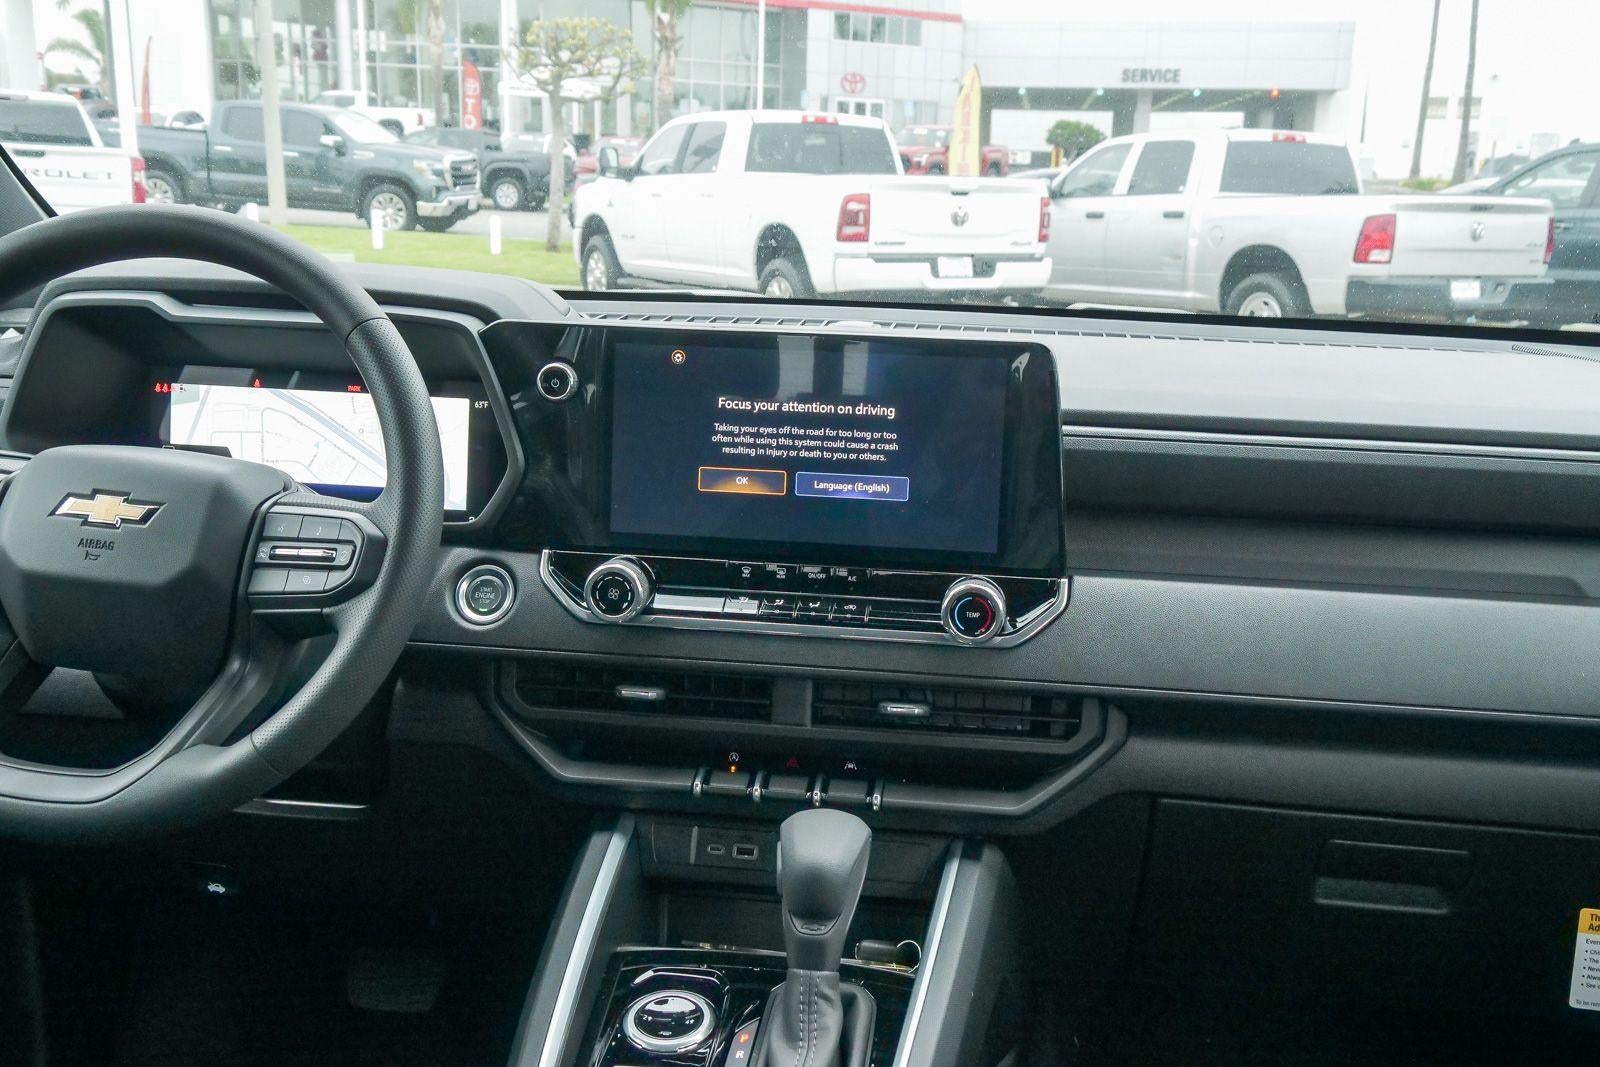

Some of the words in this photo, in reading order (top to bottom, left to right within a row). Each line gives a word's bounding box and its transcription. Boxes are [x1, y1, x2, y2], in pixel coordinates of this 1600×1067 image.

[1121, 67, 1183, 84] SERVICE
[347, 385, 362, 393] PARK
[718, 397, 752, 410] Focus
[753, 401, 779, 413] your
[781, 402, 835, 414] attention
[837, 405, 852, 415] on
[855, 403, 896, 419] driving
[714, 423, 739, 434] Taking
[740, 426, 758, 436] your
[759, 426, 777, 436] eyes
[778, 426, 791, 435] off
[791, 427, 805, 436] the
[806, 428, 824, 437] road
[825, 428, 837, 437] for
[838, 430, 853, 438] too
[853, 429, 872, 440] long
[873, 431, 882, 439] or
[883, 431, 897, 440] too
[711, 434, 733, 443] often
[734, 435, 755, 444] while
[756, 436, 777, 447] using
[778, 437, 793, 446] this
[794, 439, 822, 449] system
[823, 439, 845, 449] could
[846, 441, 869, 450] cause
[876, 442, 899, 451] crash
[722, 446, 756, 457] resulting
[757, 447, 765, 455] in
[766, 447, 788, 459] injury
[789, 449, 798, 457] or
[799, 448, 822, 458] death
[823, 450, 831, 459] to
[833, 452, 848, 462] you
[849, 452, 858, 460] or
[859, 452, 887, 462] others.
[735, 476, 749, 485] OK
[814, 480, 853, 493] Language
[854, 482, 890, 494] (English)
[77, 538, 115, 551] AIRBAG
[807, 572, 827, 580] ON/OFF
[739, 1033, 748, 1043] P
[735, 1050, 745, 1059] R
